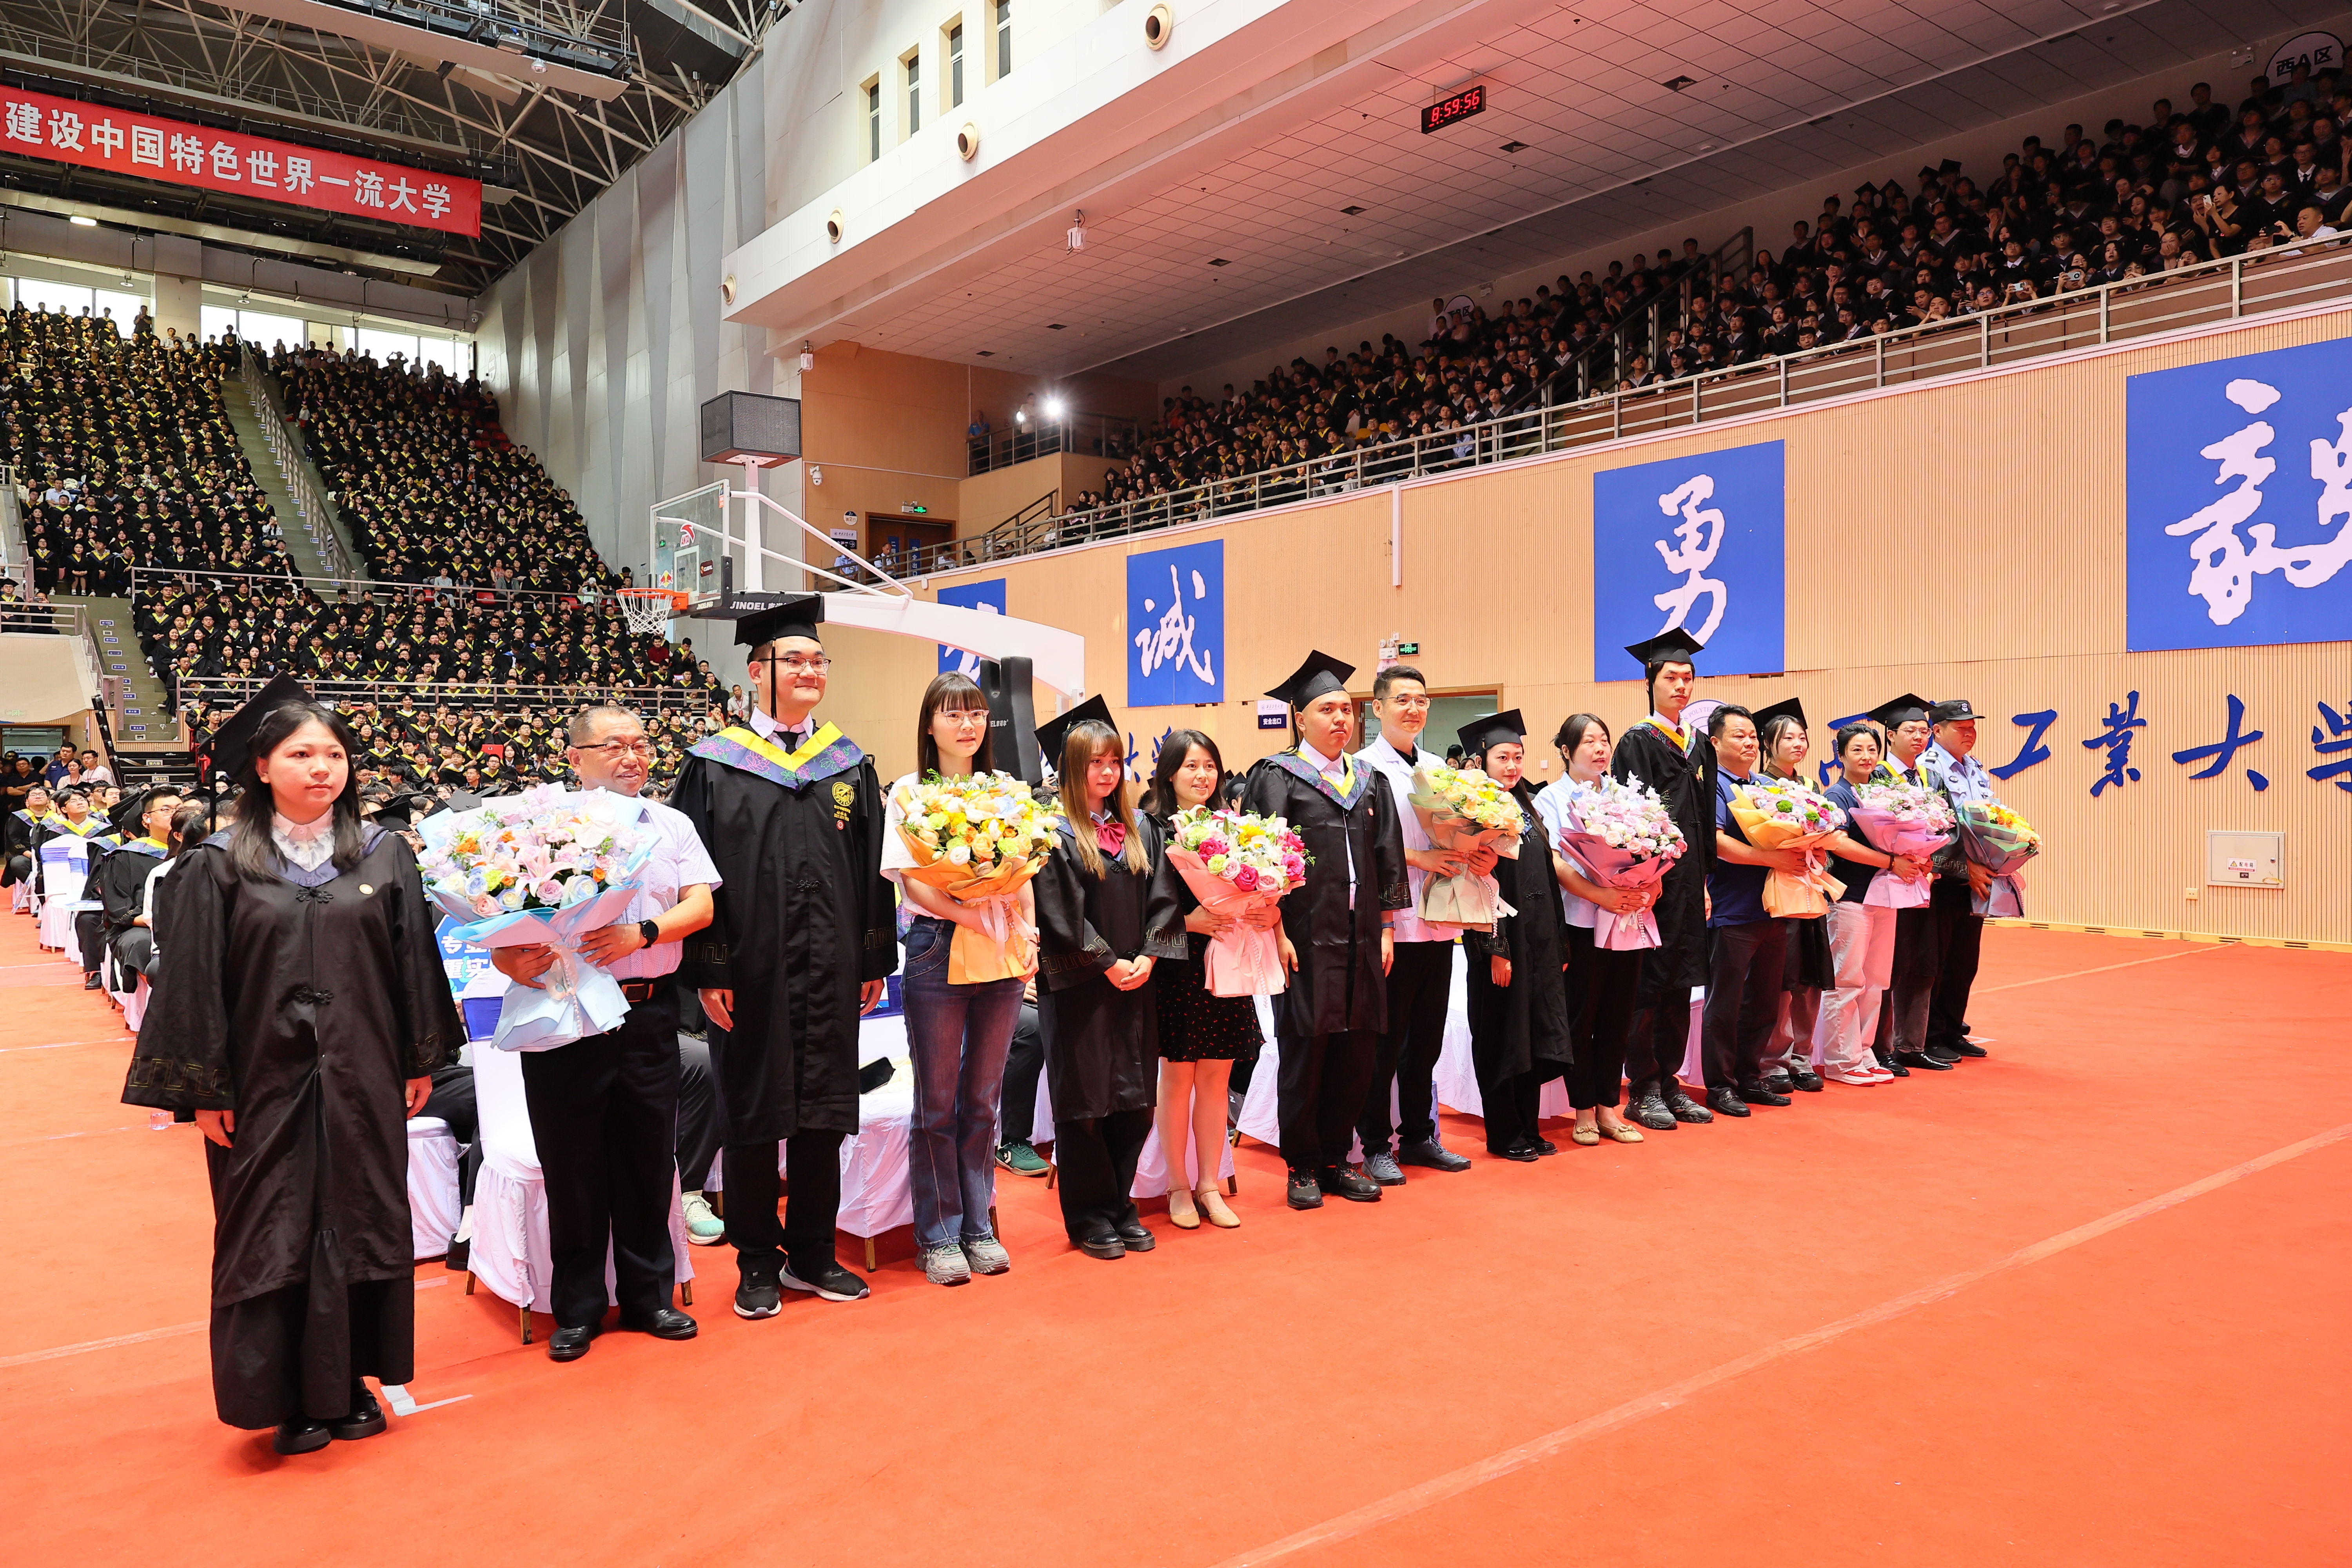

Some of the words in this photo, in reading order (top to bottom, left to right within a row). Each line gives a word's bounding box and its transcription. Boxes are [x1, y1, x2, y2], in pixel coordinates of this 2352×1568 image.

[5, 101, 451, 219] 建设中国特色世界一流大学
[1431, 90, 1480, 122] 8:59:56
[730, 601, 767, 610] JINOEL
[1653, 474, 1728, 647] 勇
[1135, 564, 1216, 686] 诚
